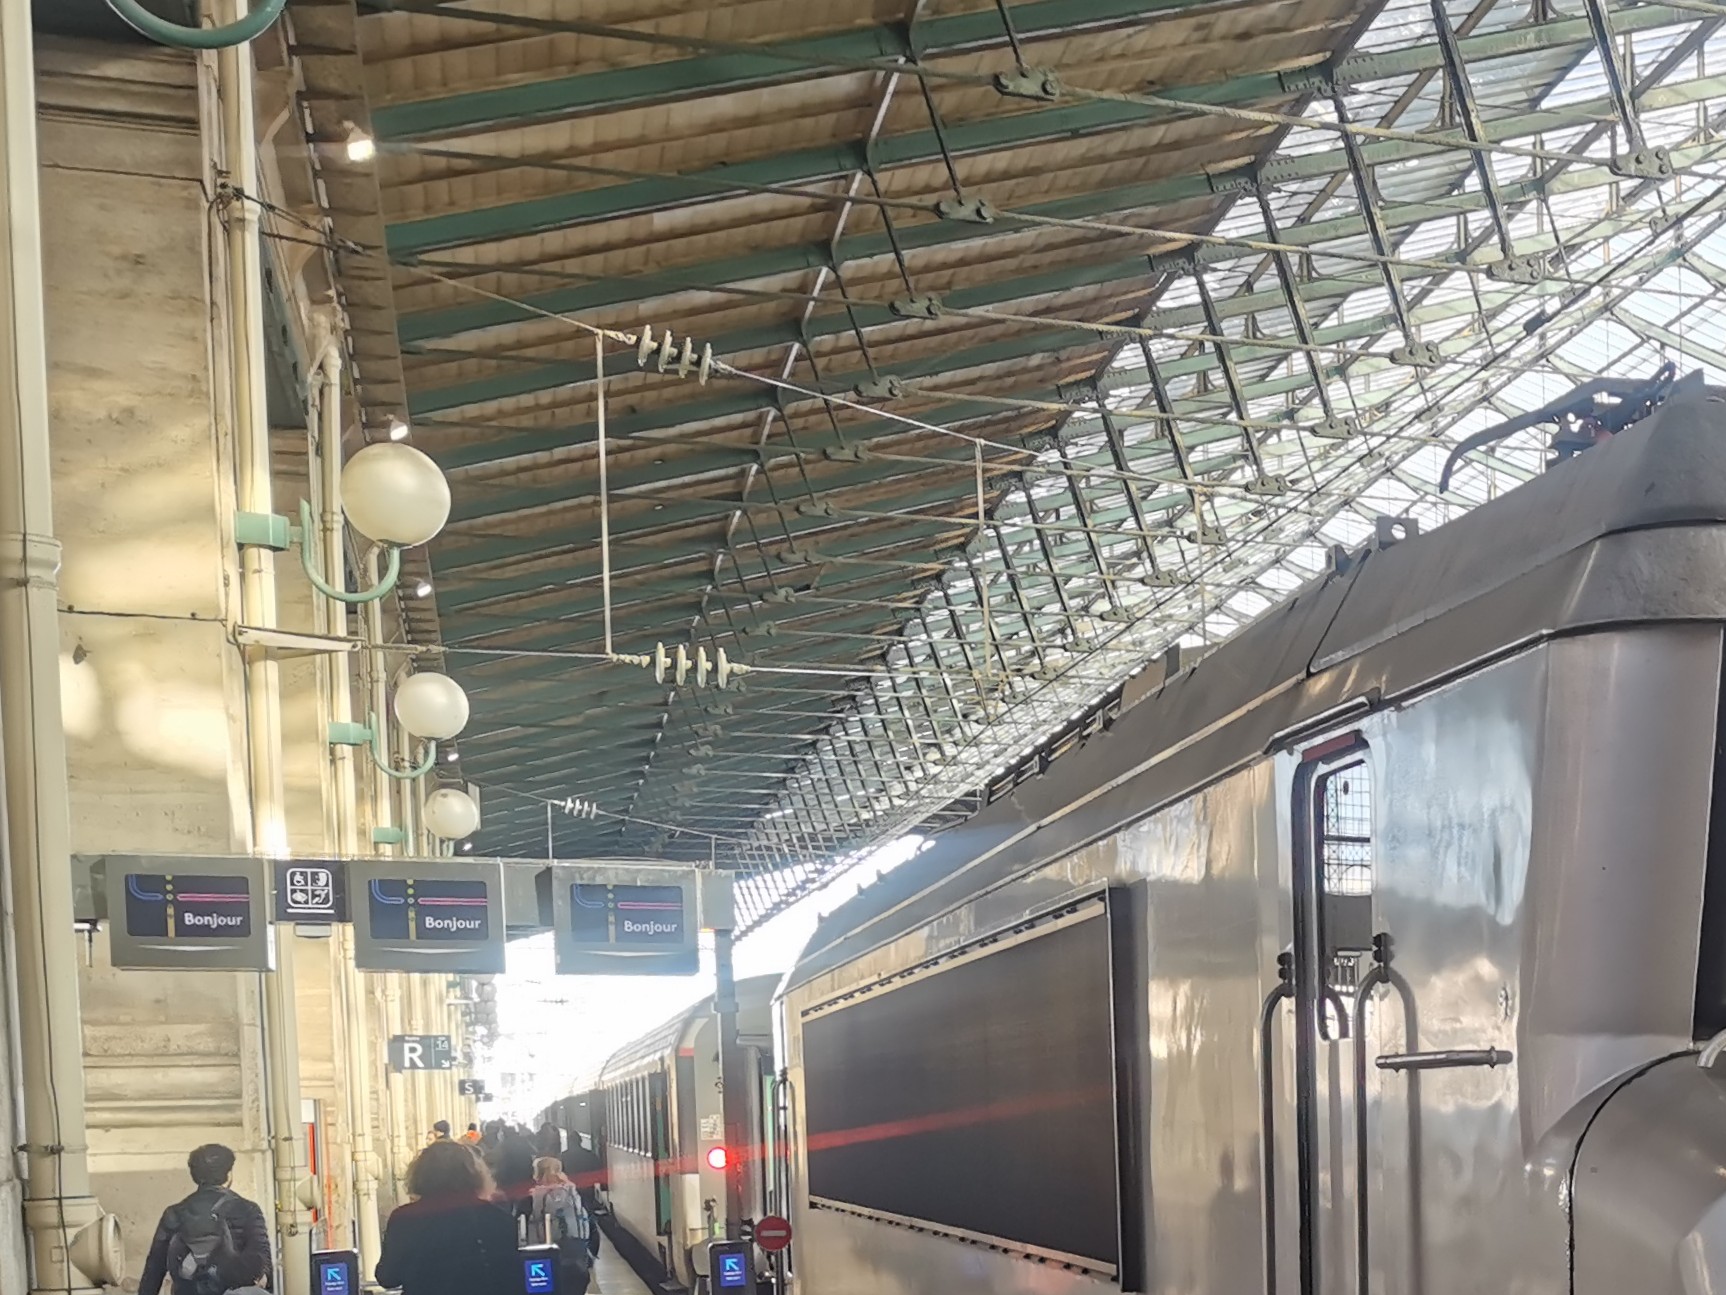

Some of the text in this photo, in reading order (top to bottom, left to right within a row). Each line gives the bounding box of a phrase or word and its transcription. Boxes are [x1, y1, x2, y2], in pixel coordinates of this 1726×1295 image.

[184, 913, 243, 929] Bonjour
[425, 916, 481, 932] Bonjour
[624, 919, 678, 935] Bonjour
[403, 1042, 424, 1068] R
[464, 1082, 474, 1094] S
